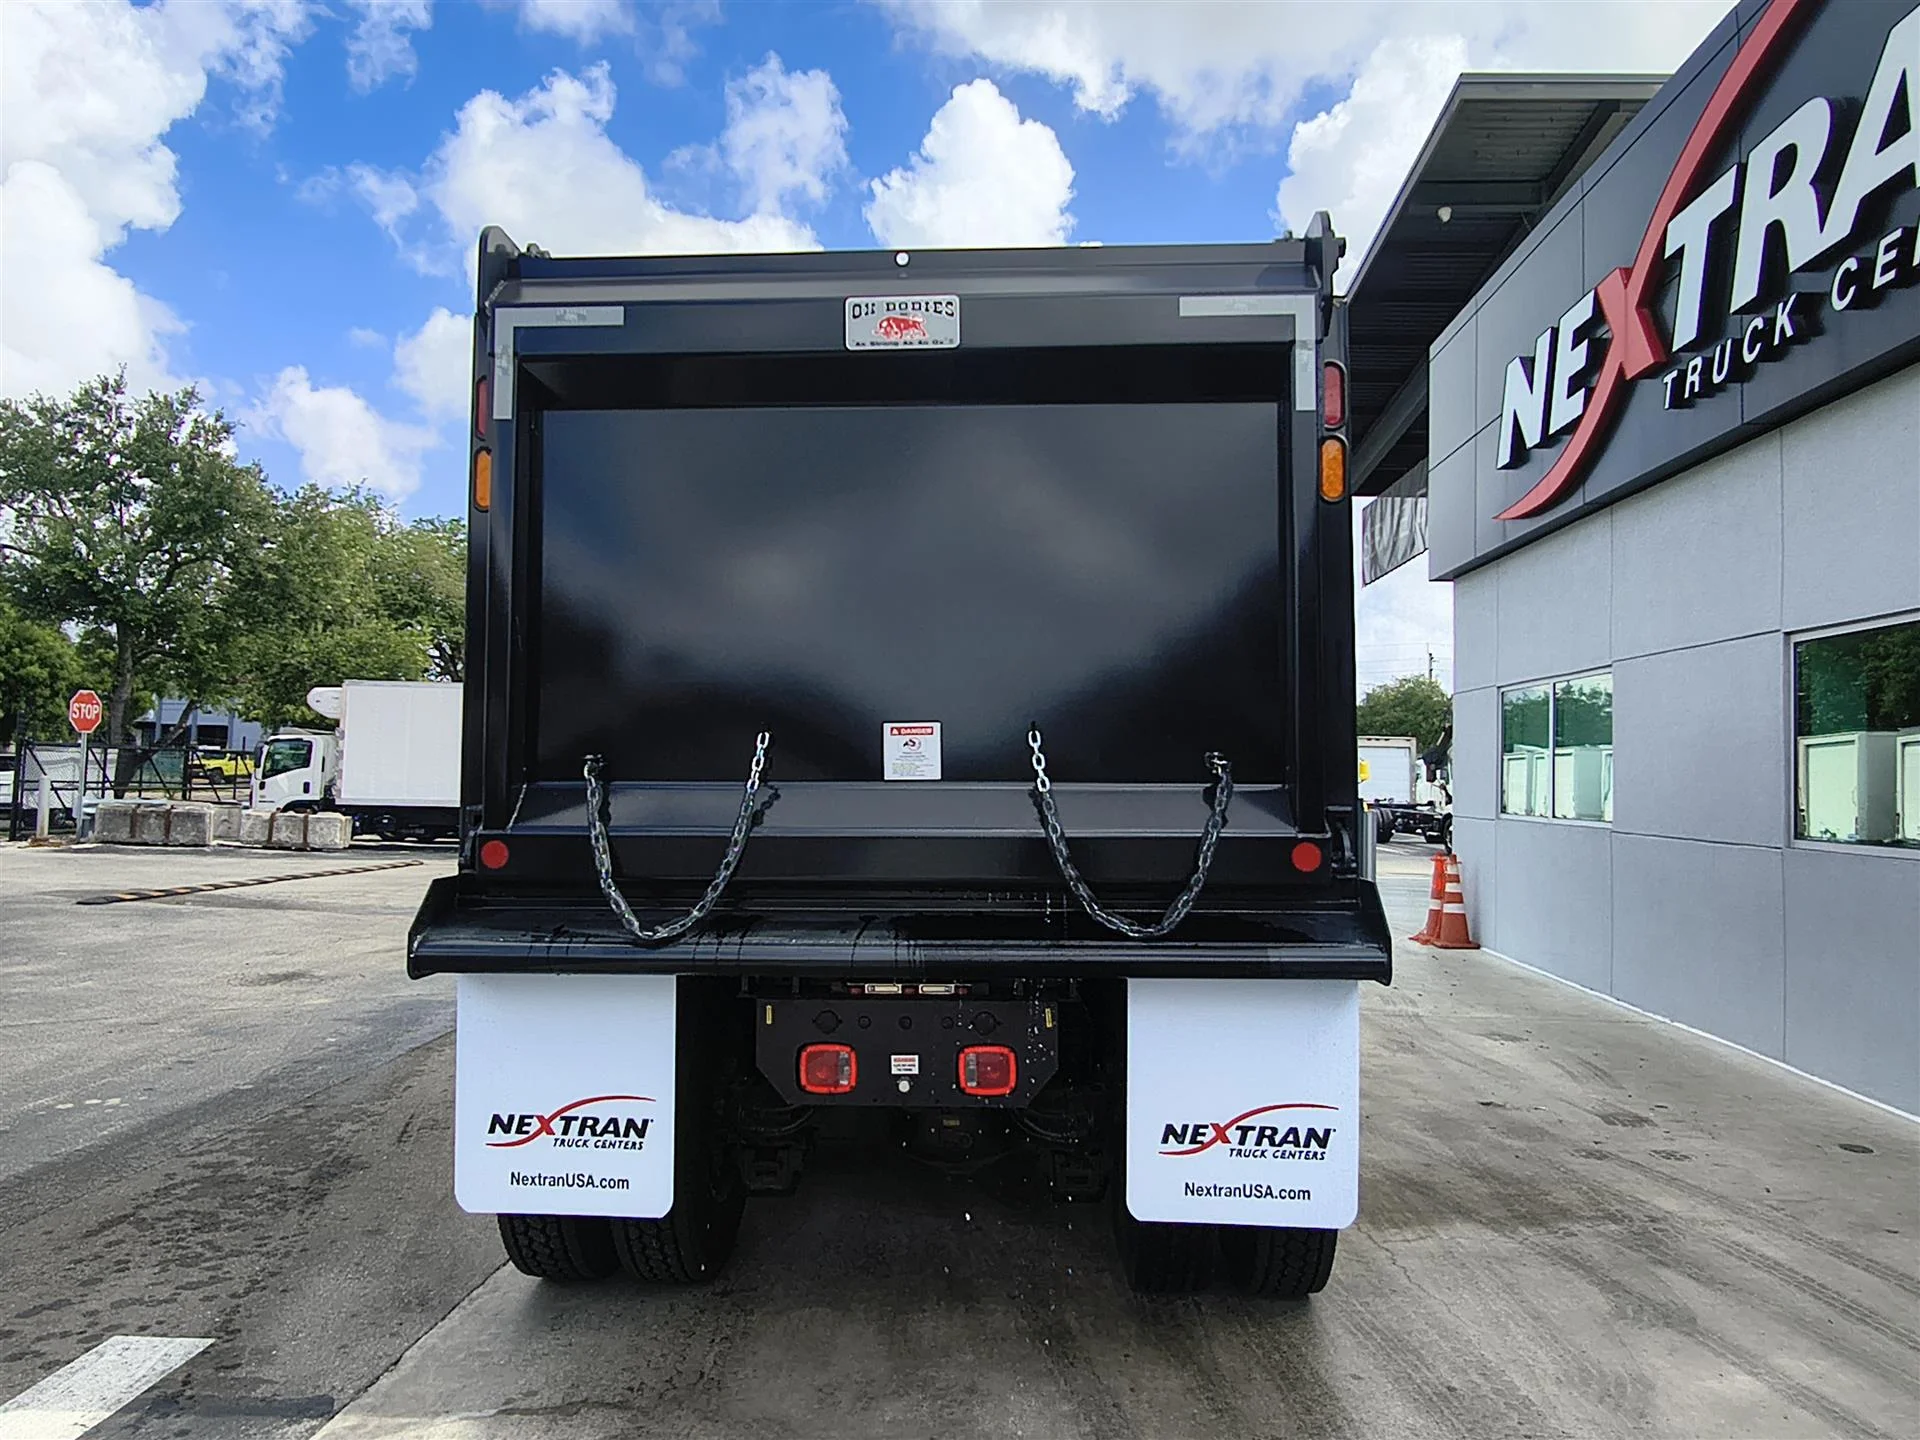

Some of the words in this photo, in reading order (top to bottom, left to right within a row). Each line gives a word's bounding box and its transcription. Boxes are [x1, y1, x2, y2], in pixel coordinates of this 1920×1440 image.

[1663, 293, 1798, 411] TRUCK
[1831, 212, 1920, 312] CE
[72, 703, 100, 719] STOP
[487, 1113, 651, 1139] NEXTRAN
[553, 1138, 589, 1149] TRUCK
[594, 1139, 644, 1150] CENTERS
[1160, 1122, 1333, 1149] NEXTRAN
[1229, 1148, 1267, 1159] TRUCK
[1272, 1150, 1326, 1161] CENTERS
[510, 1172, 630, 1190] NextranUSA.com
[1184, 1182, 1311, 1201] NextranUSA.com
